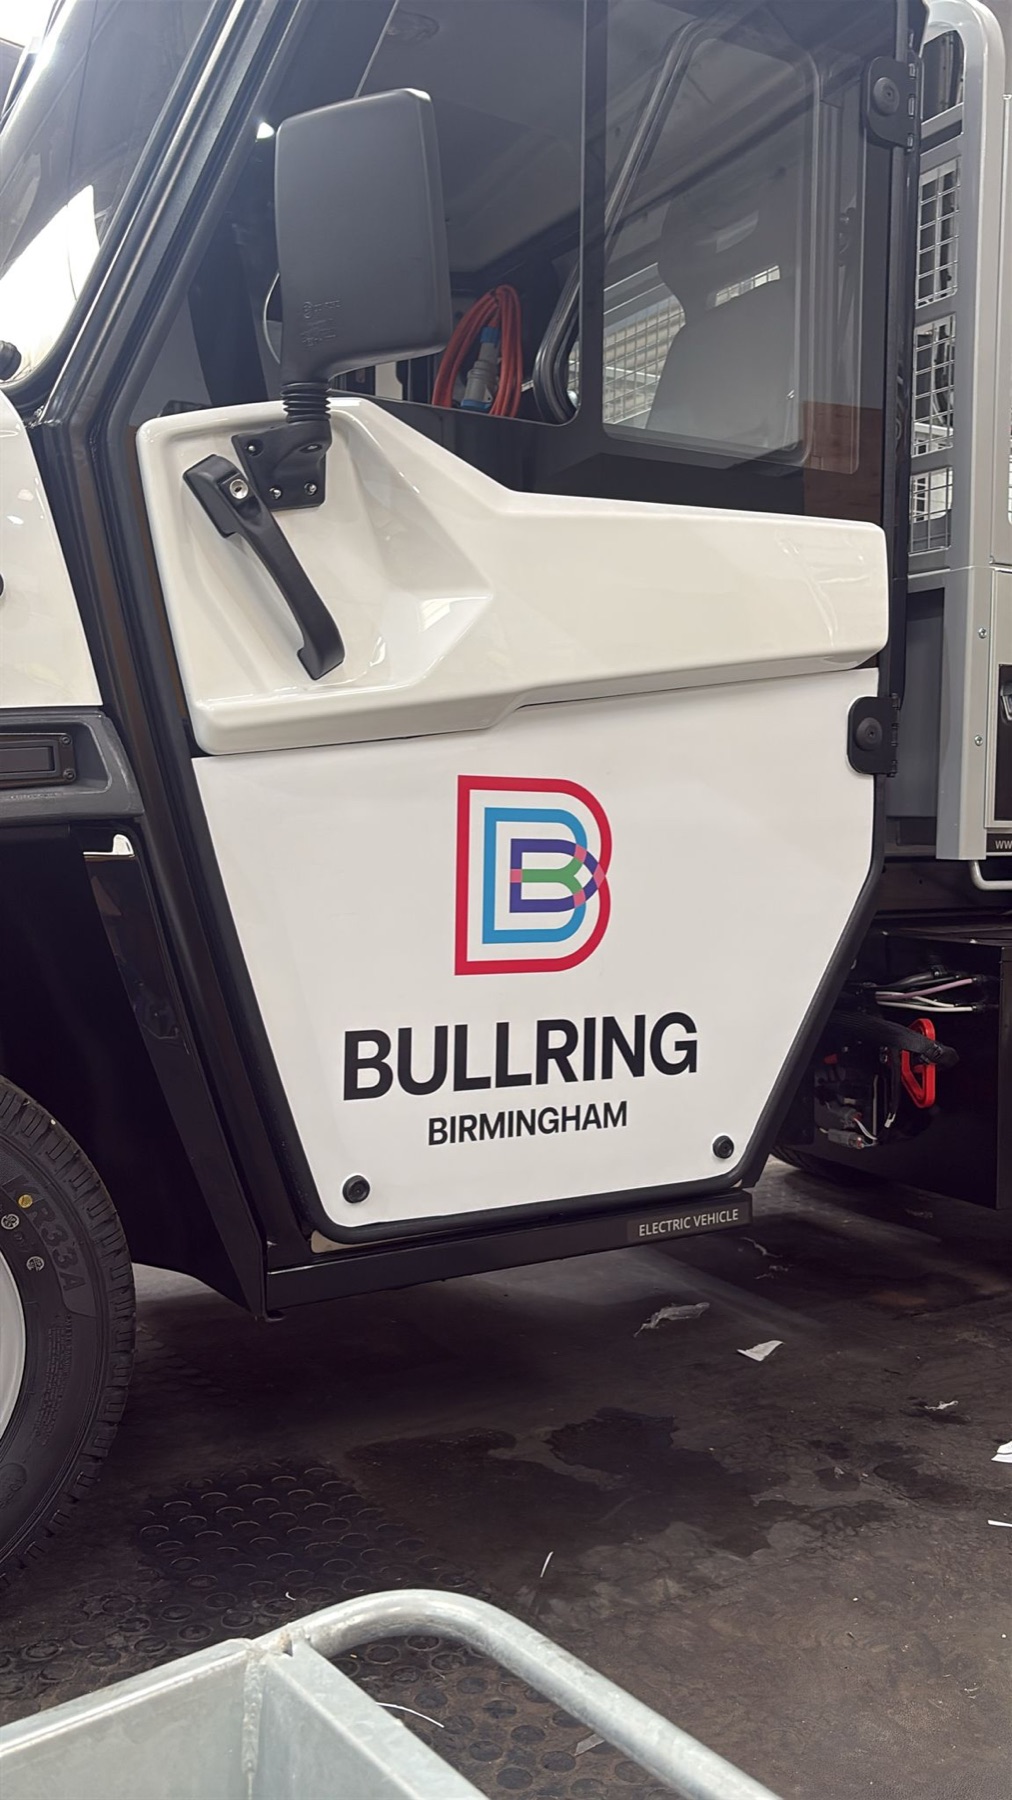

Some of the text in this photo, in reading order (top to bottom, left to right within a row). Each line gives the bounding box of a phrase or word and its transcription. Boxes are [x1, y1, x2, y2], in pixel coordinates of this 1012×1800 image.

[343, 1011, 698, 1101] BULLRING
[428, 1100, 628, 1146] BIRMINGHAM
[639, 1208, 739, 1237] ELECTRIC VEHICLE
